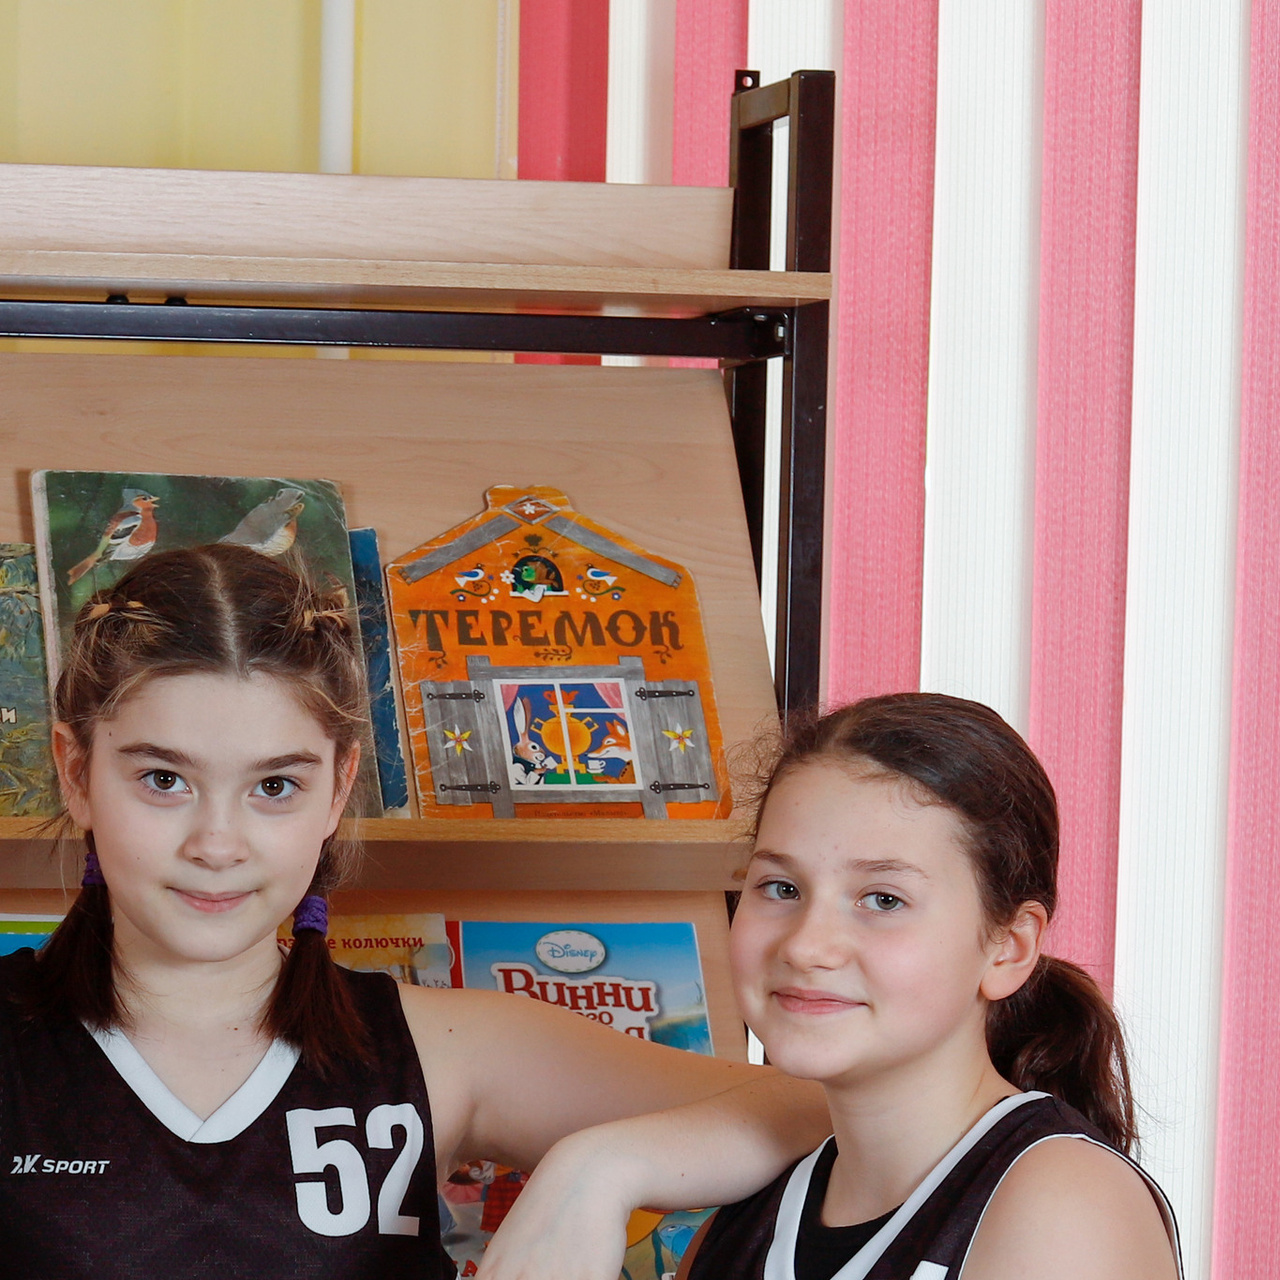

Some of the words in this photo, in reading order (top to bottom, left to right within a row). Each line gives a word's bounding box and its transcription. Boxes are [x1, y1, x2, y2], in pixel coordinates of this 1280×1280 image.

[408, 609, 686, 652] ТЕРЕМОК
[342, 936, 426, 950] колючки
[497, 967, 656, 1013] Винни
[41, 1158, 111, 1175] SPORT
[284, 1102, 425, 1238] 52
